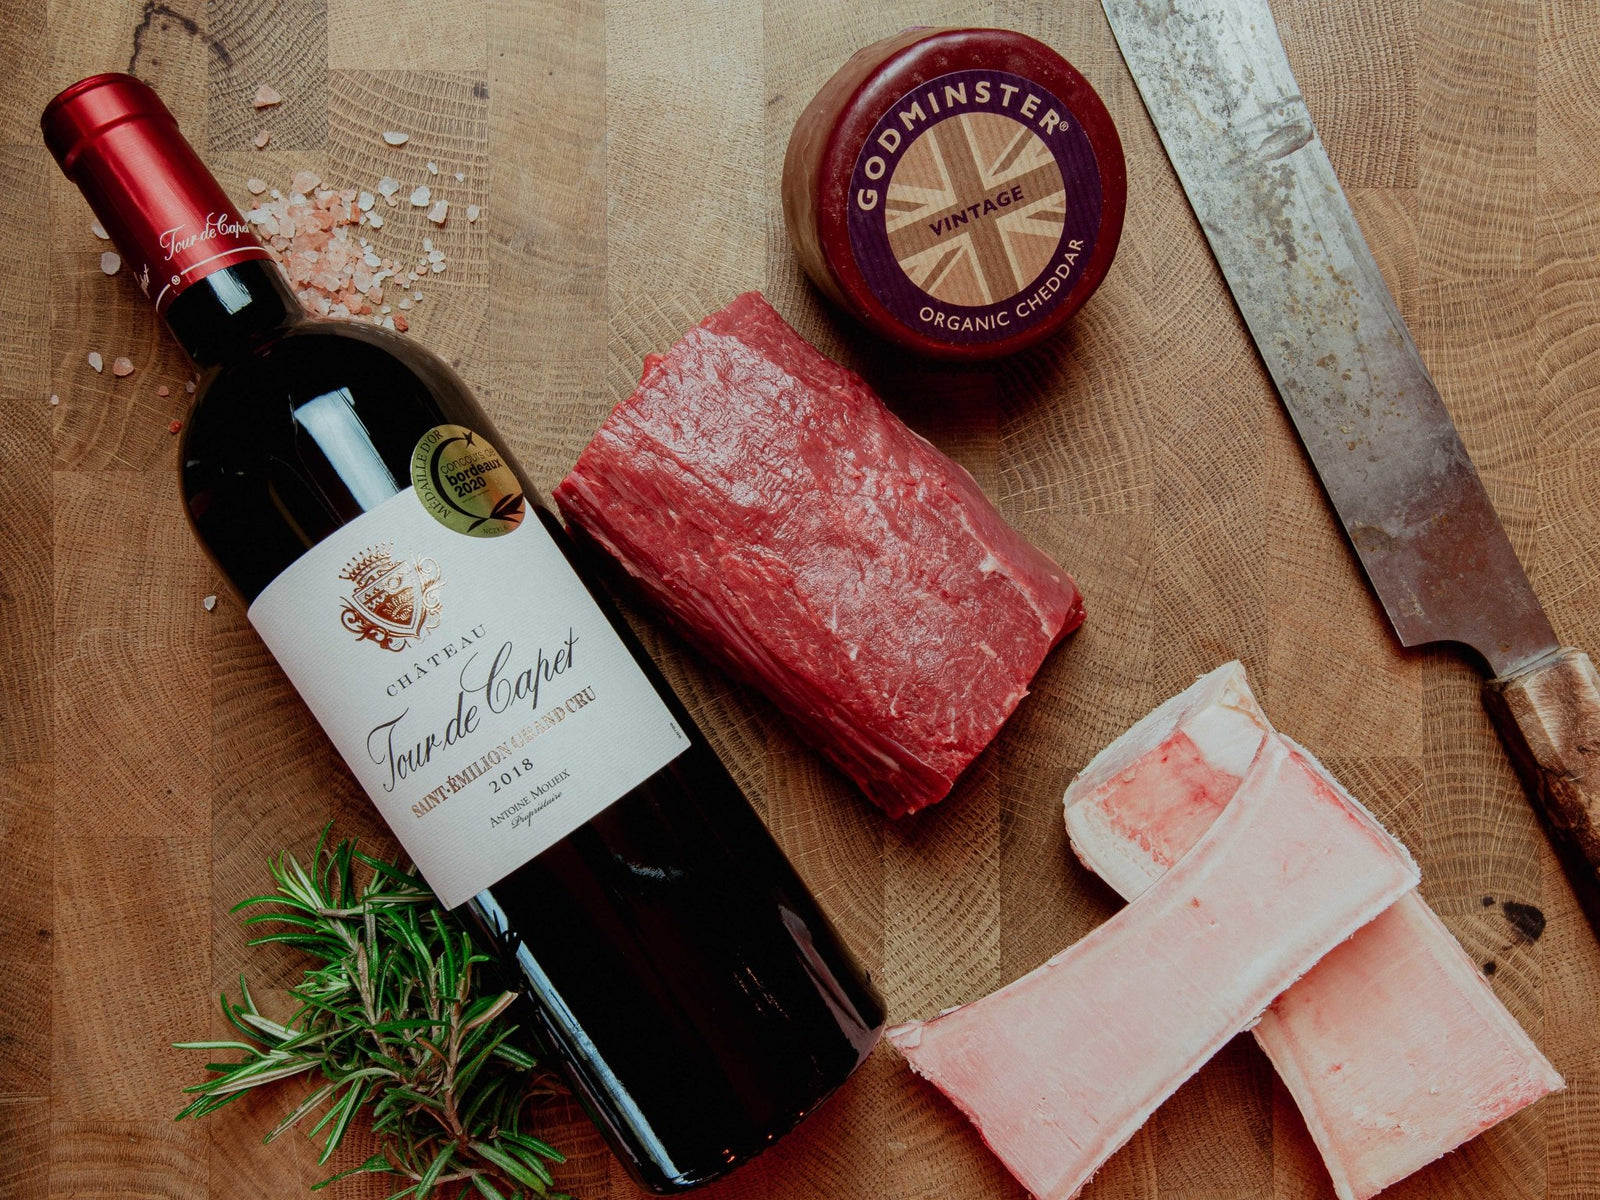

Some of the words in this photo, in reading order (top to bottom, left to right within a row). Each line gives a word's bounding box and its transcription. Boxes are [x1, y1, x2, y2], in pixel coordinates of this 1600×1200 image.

[928, 185, 1025, 236] VINTAGE
[160, 223, 199, 261] Tour
[199, 223, 217, 241] de
[919, 305, 1011, 332] ORGANIC
[1015, 238, 1085, 318] CHEDDAR
[420, 429, 444, 453] D'OR
[440, 451, 486, 475] concours
[485, 447, 496, 457] de
[415, 453, 452, 519] MÉDAILLE
[445, 459, 503, 487] bordeaux
[454, 476, 487, 498] 2020
[386, 624, 487, 698] CHÂTEAU
[459, 626, 580, 715] Capet
[442, 690, 482, 752] de
[511, 706, 567, 750] GRAND
[565, 685, 597, 714] CRU
[366, 706, 443, 793] Tour
[488, 758, 534, 794] 2018
[511, 790, 564, 830] Propriétaire
